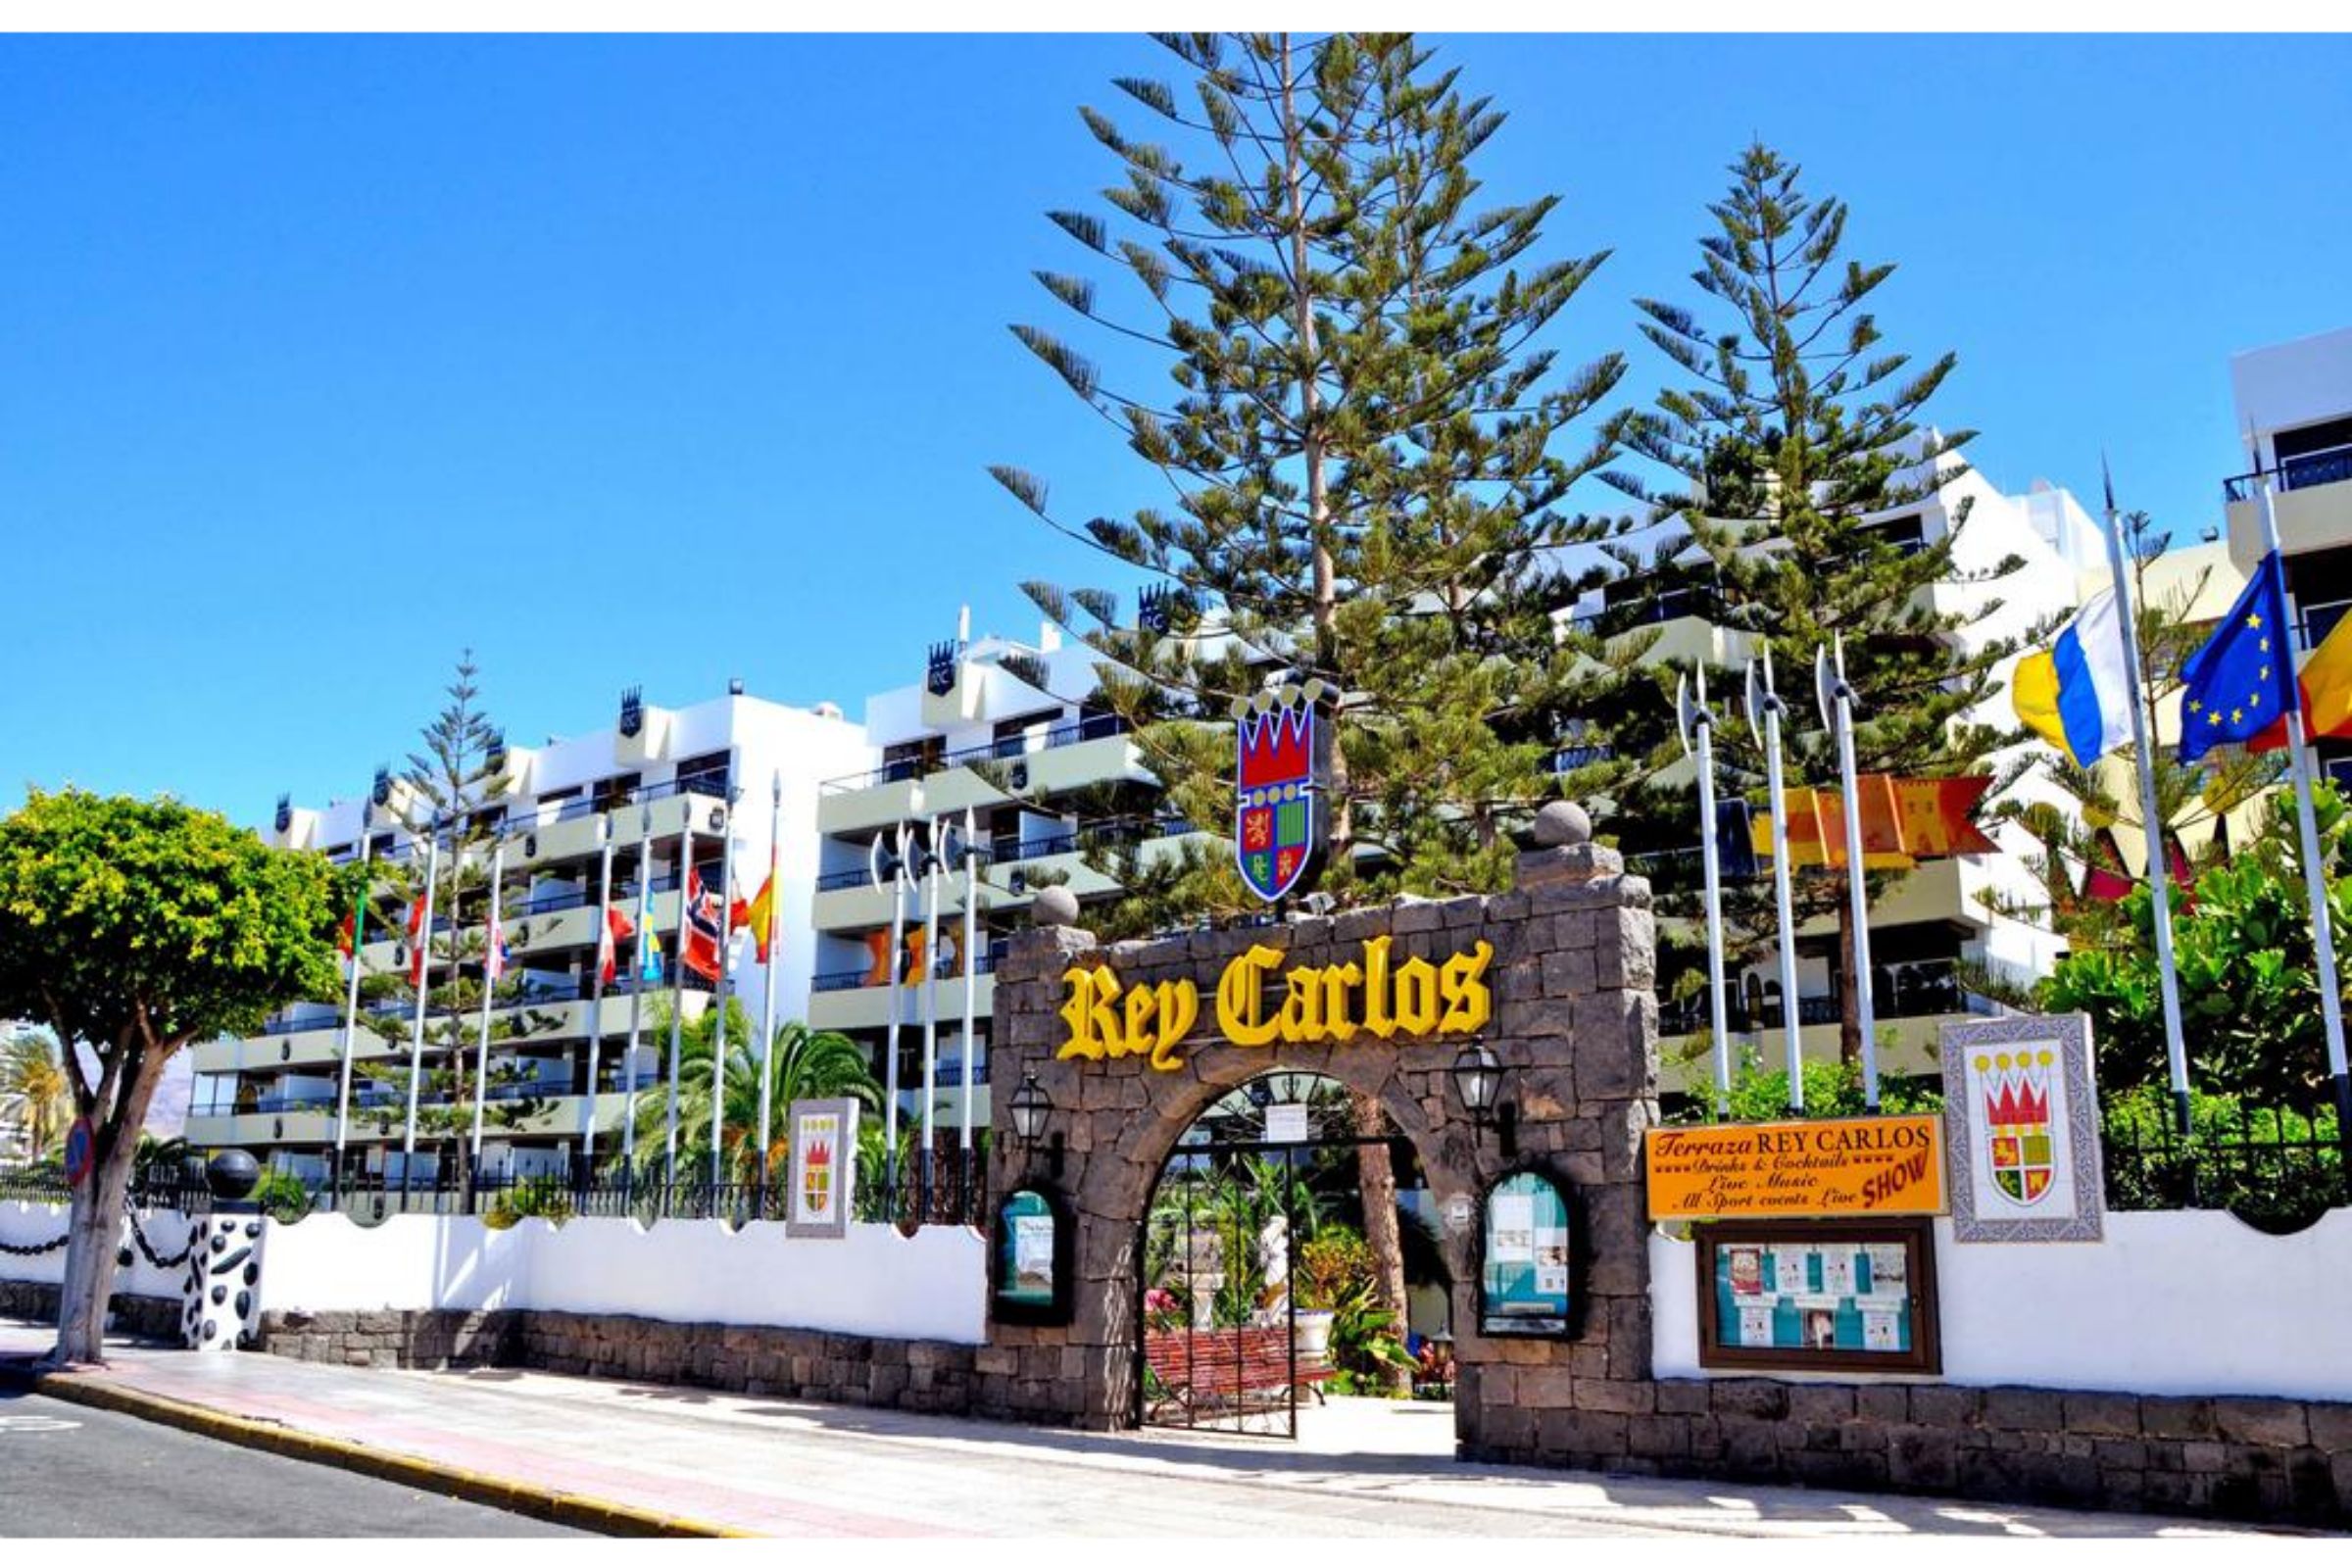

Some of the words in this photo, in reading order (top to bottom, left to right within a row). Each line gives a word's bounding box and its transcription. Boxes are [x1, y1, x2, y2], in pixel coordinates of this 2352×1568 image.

[1056, 963, 1199, 1071] Rey
[1216, 935, 1494, 1046] Carlos
[1654, 1133, 1752, 1157] Terraza
[1756, 1131, 1809, 1153] REY
[1816, 1125, 1931, 1152] CARLOS
[1692, 1157, 1746, 1173] Drinks
[1753, 1155, 1767, 1170] &
[1773, 1150, 1848, 1170] Cocktails
[1702, 1175, 1747, 1194] Live
[1756, 1172, 1818, 1189] Music
[1862, 1146, 1930, 1209] SHOW
[1672, 1192, 1702, 1209] All
[1706, 1192, 1753, 1213] Sport
[1758, 1192, 1809, 1206] events
[1817, 1187, 1857, 1207] Live
